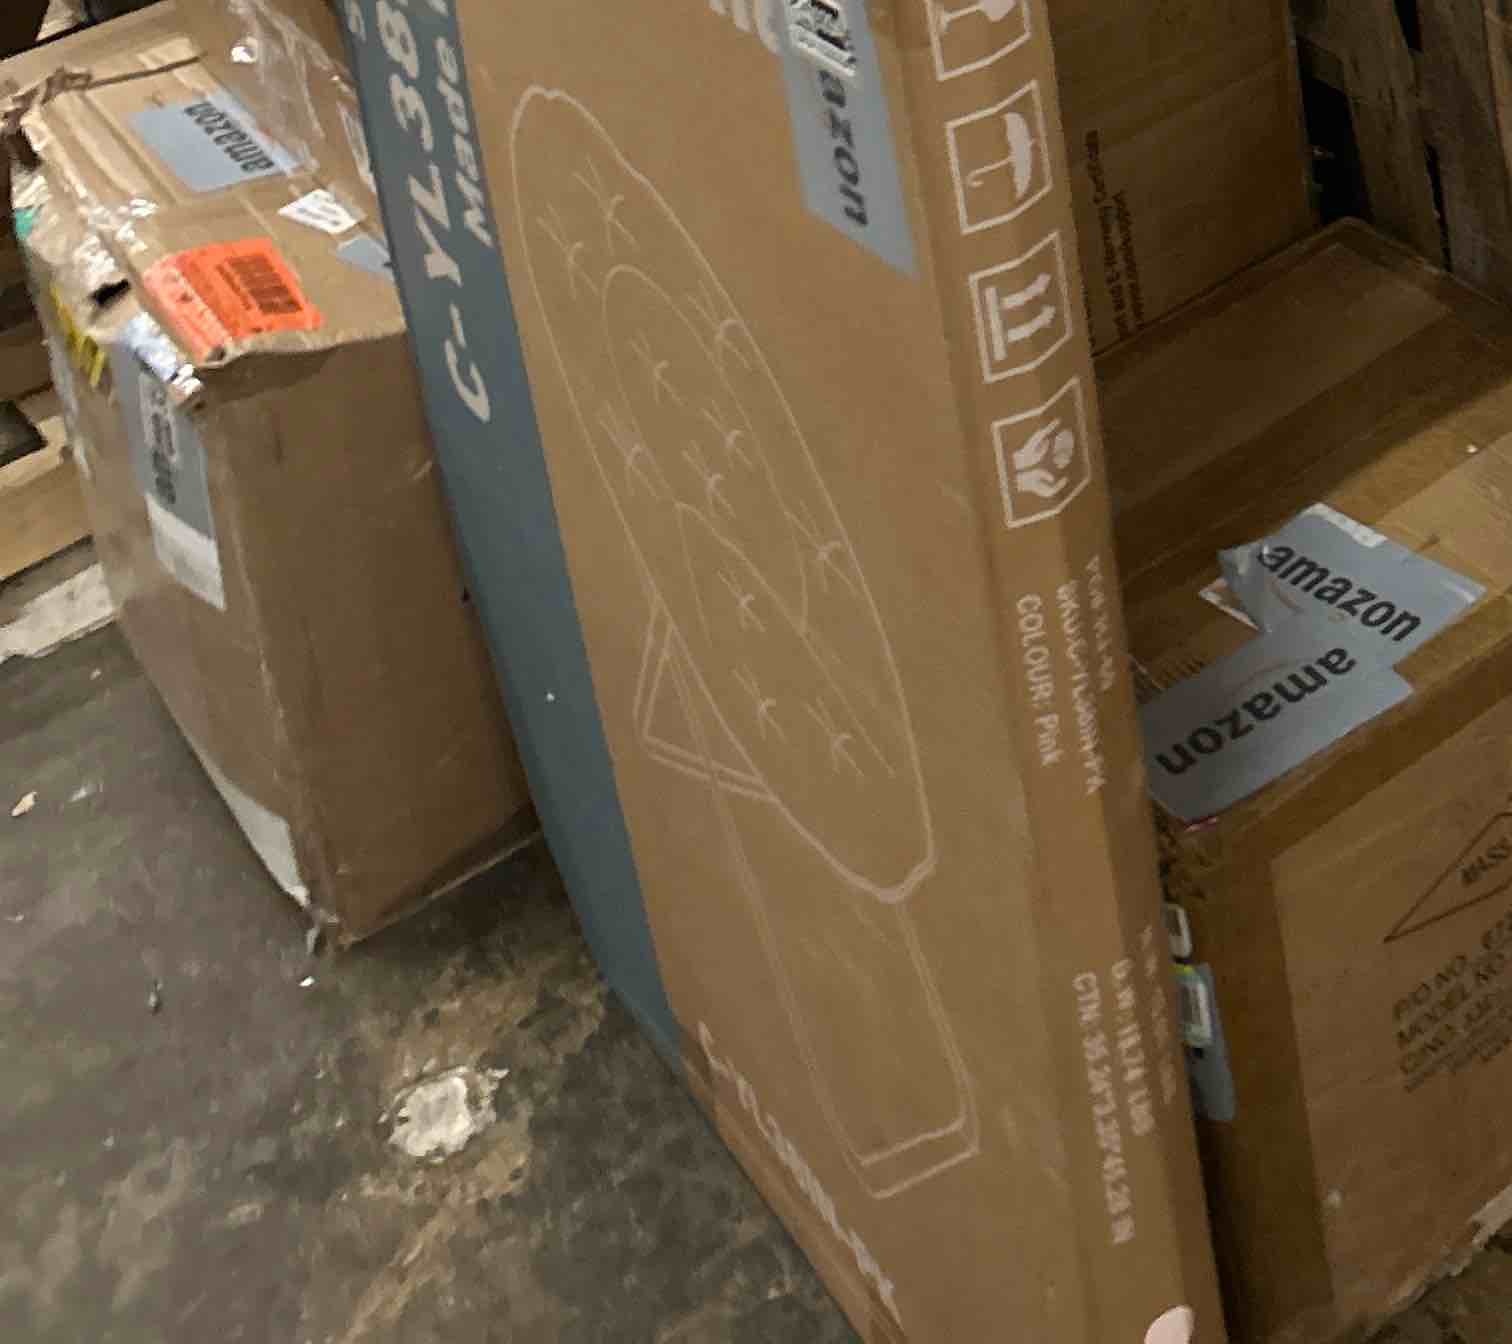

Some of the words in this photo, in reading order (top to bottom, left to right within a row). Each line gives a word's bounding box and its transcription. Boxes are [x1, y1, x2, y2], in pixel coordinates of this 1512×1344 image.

[184, 100, 275, 175] amazon
[432, 36, 494, 248] Made
[1256, 539, 1423, 644] amazon
[1154, 645, 1358, 776] amazon
